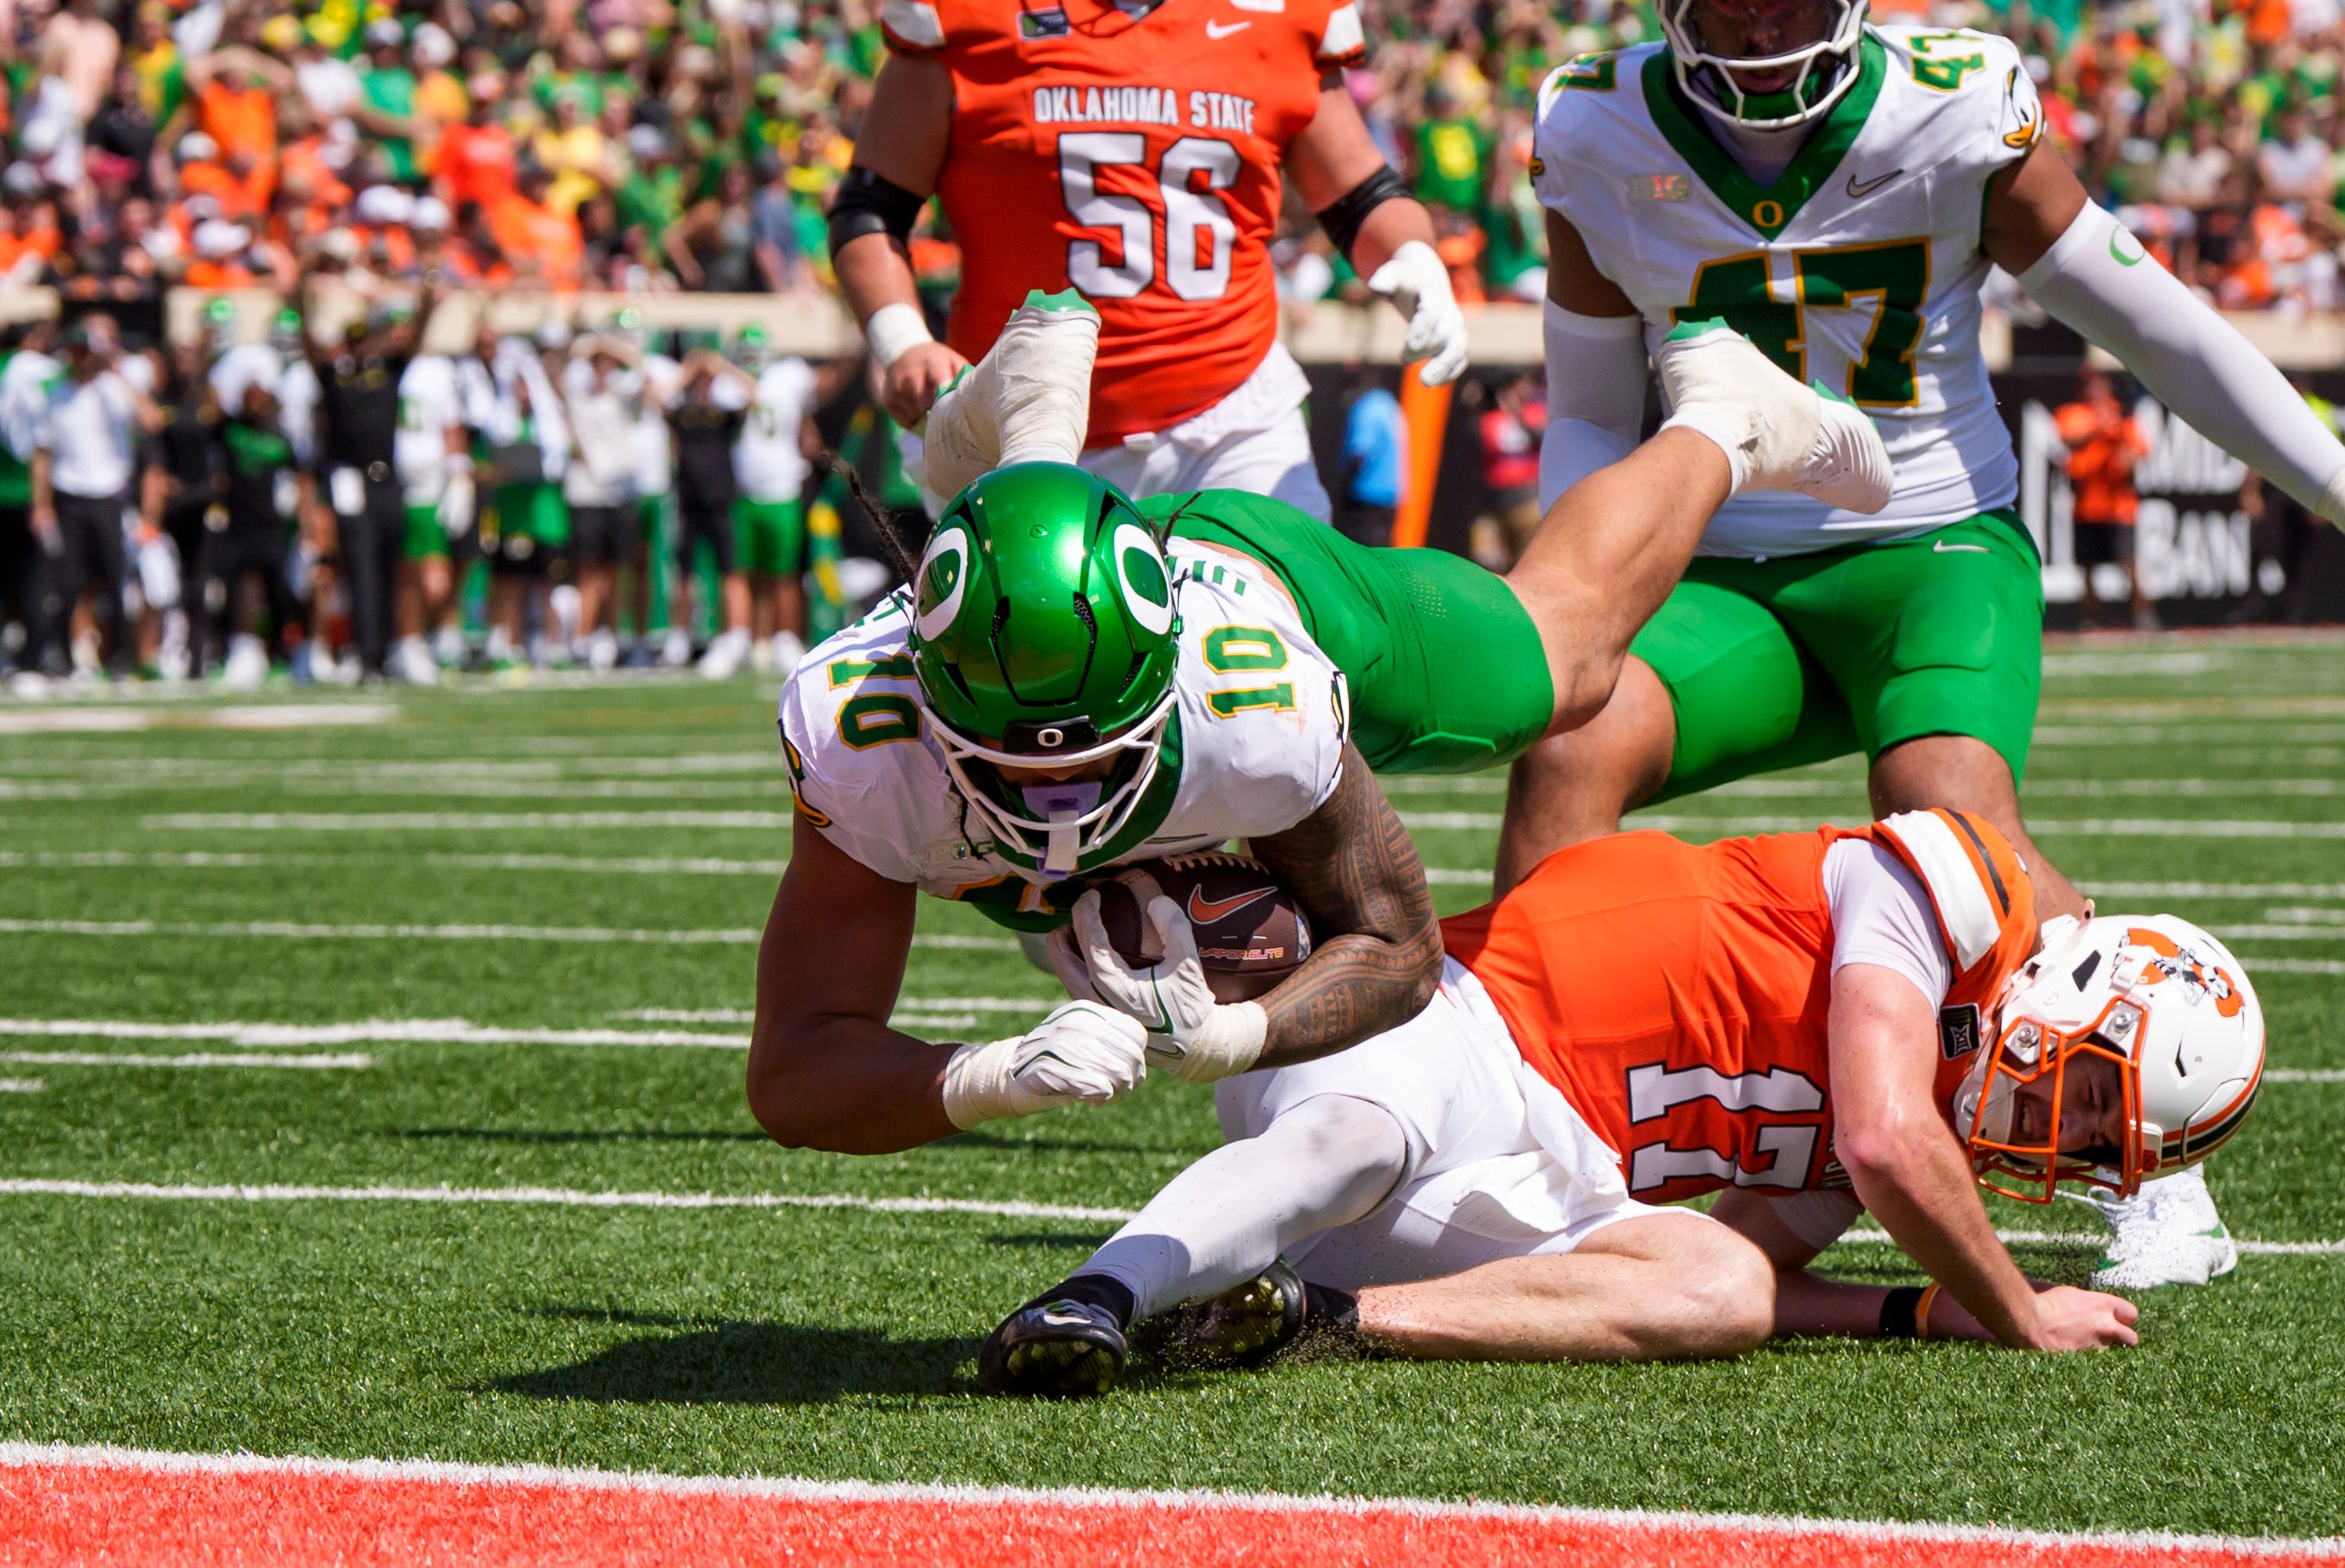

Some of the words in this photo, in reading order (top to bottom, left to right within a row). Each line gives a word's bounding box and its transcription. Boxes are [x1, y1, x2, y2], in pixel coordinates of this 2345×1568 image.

[1033, 86, 1179, 125] OKLAHOMA
[1190, 90, 1256, 135] STATE
[1057, 132, 1242, 302] 56
[1752, 199, 1784, 228] O
[827, 652, 923, 753] 10
[1201, 624, 1297, 719] 10
[1037, 727, 1063, 747] O
[1248, 946, 1284, 960] ELITE
[1626, 1061, 1826, 1194] 17
